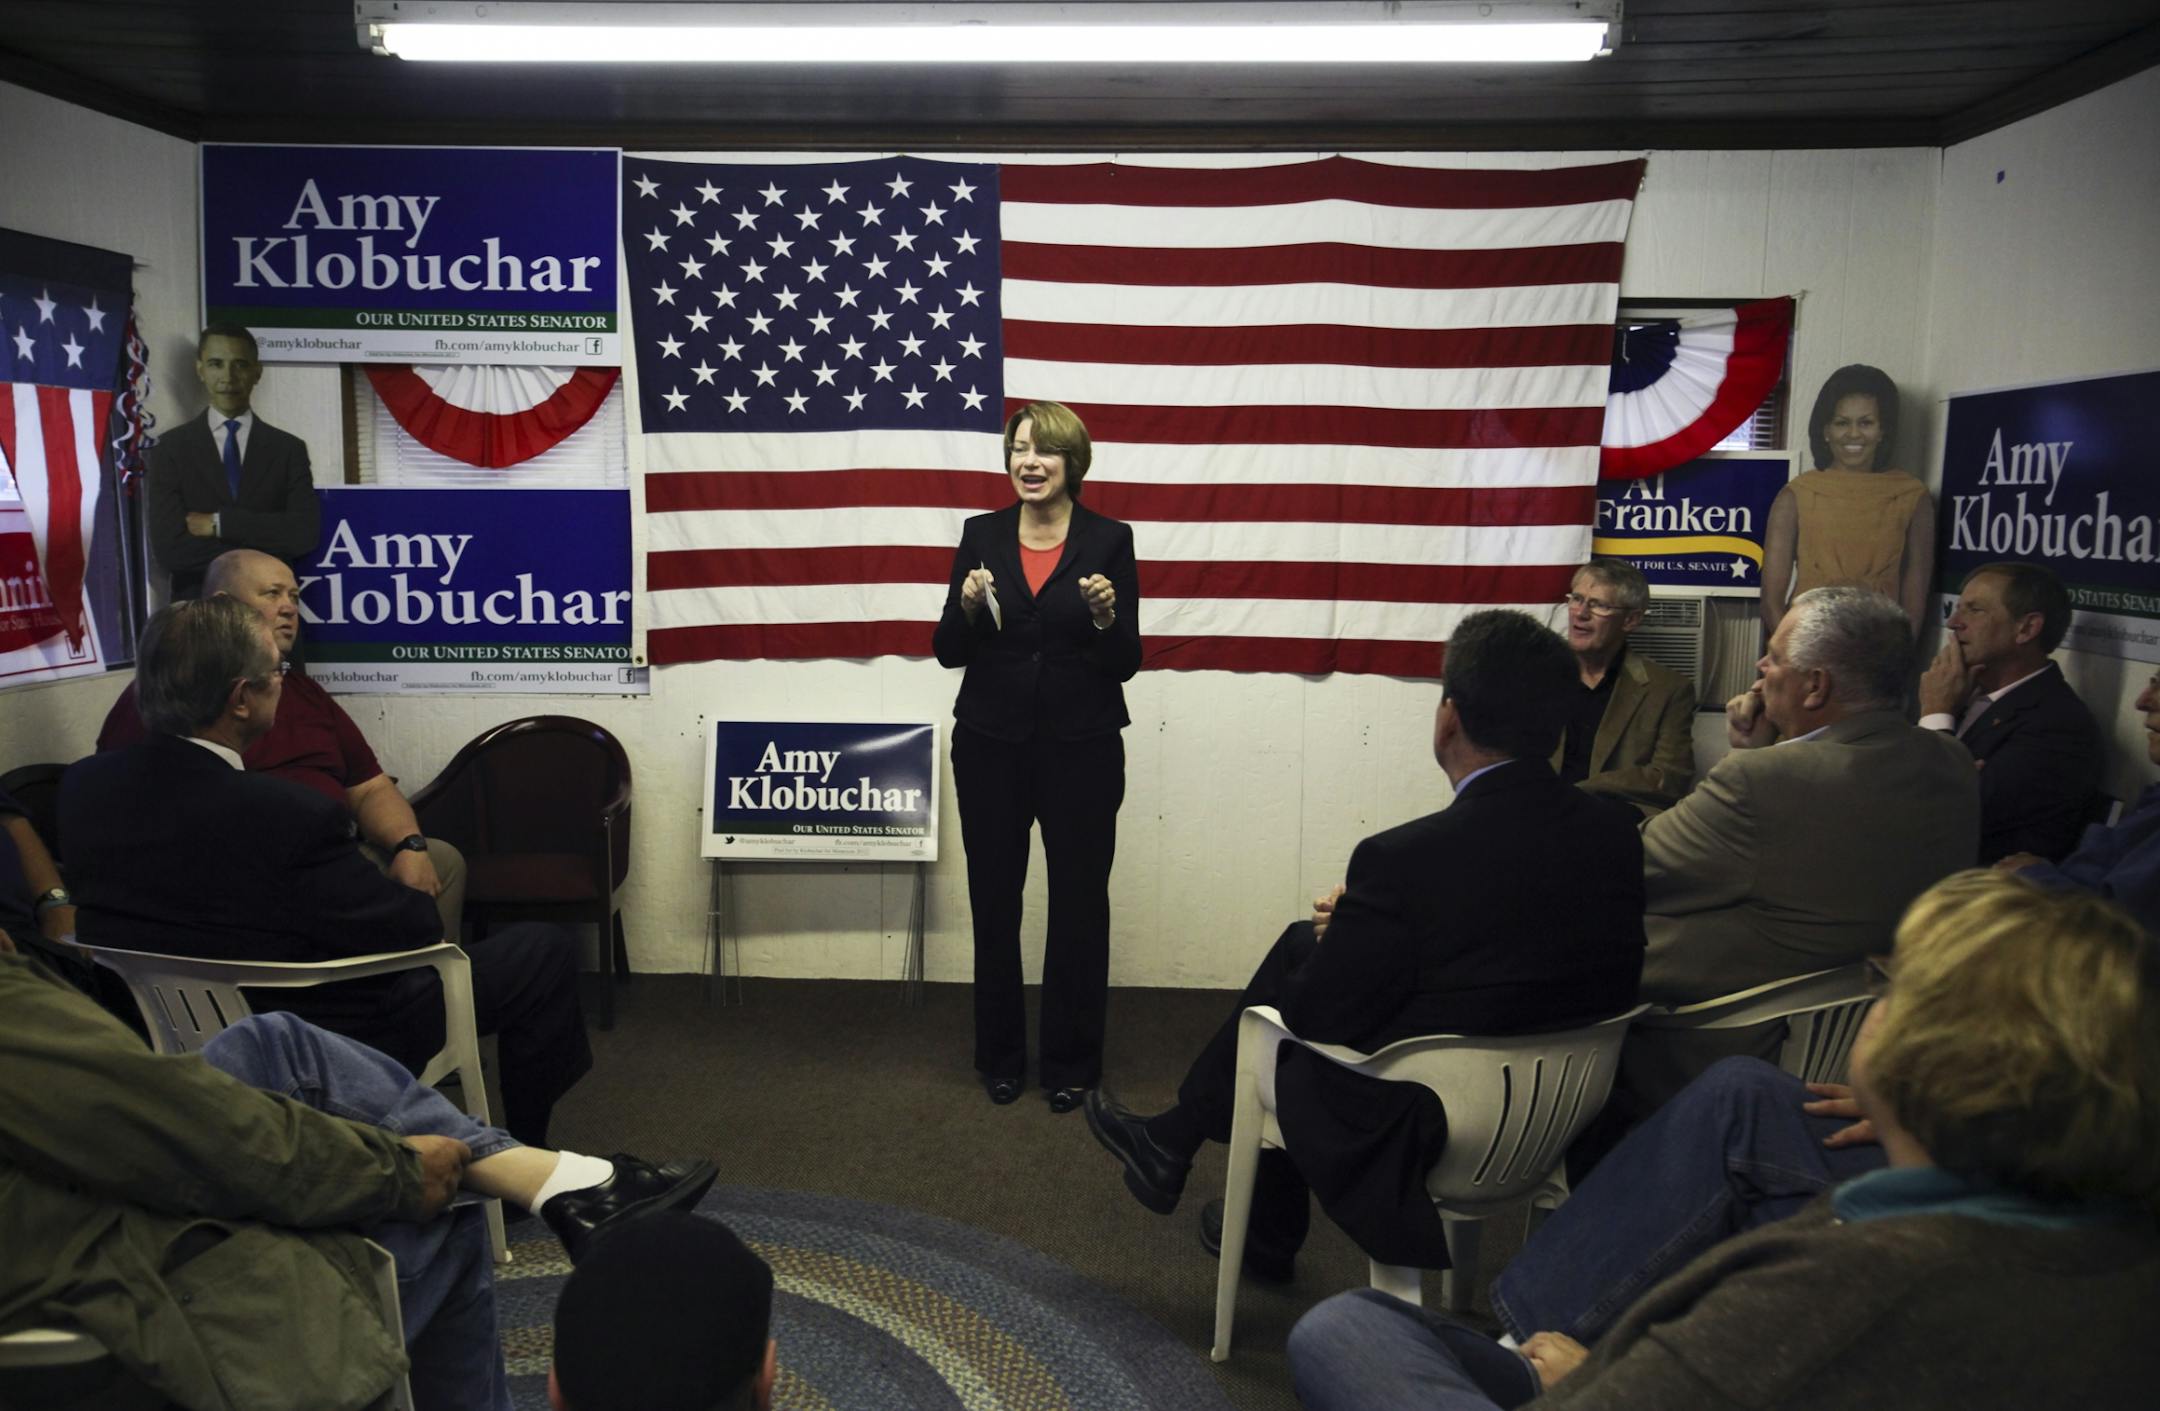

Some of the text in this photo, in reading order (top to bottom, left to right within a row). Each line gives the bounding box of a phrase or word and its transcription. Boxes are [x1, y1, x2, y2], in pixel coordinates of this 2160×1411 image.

[283, 178, 440, 249] Amy
[233, 235, 601, 293] Klobuchar
[355, 312, 607, 329] OUR UNITED STATES SENATOR
[434, 339, 580, 354] fb.com/amyklobuchar
[1978, 427, 2074, 506] Amy
[1594, 497, 1752, 533] Franken
[316, 518, 473, 586] Amy
[1644, 561, 1665, 571] FOR
[1666, 561, 1685, 571] U.S.
[1688, 562, 1728, 572] SENATE
[298, 573, 632, 626] Klobuchar
[2077, 589, 2121, 608] STATES
[2122, 592, 2160, 613] SENAT
[392, 646, 632, 660] OUR UNITED STATES SENATO
[312, 671, 399, 685] myklobuchar
[470, 671, 613, 685] fb.com/amyklobuchar
[755, 741, 841, 783] Amy
[728, 775, 922, 812] Klobuchar
[793, 824, 925, 836] OUR UNITED STATES SENATOR
